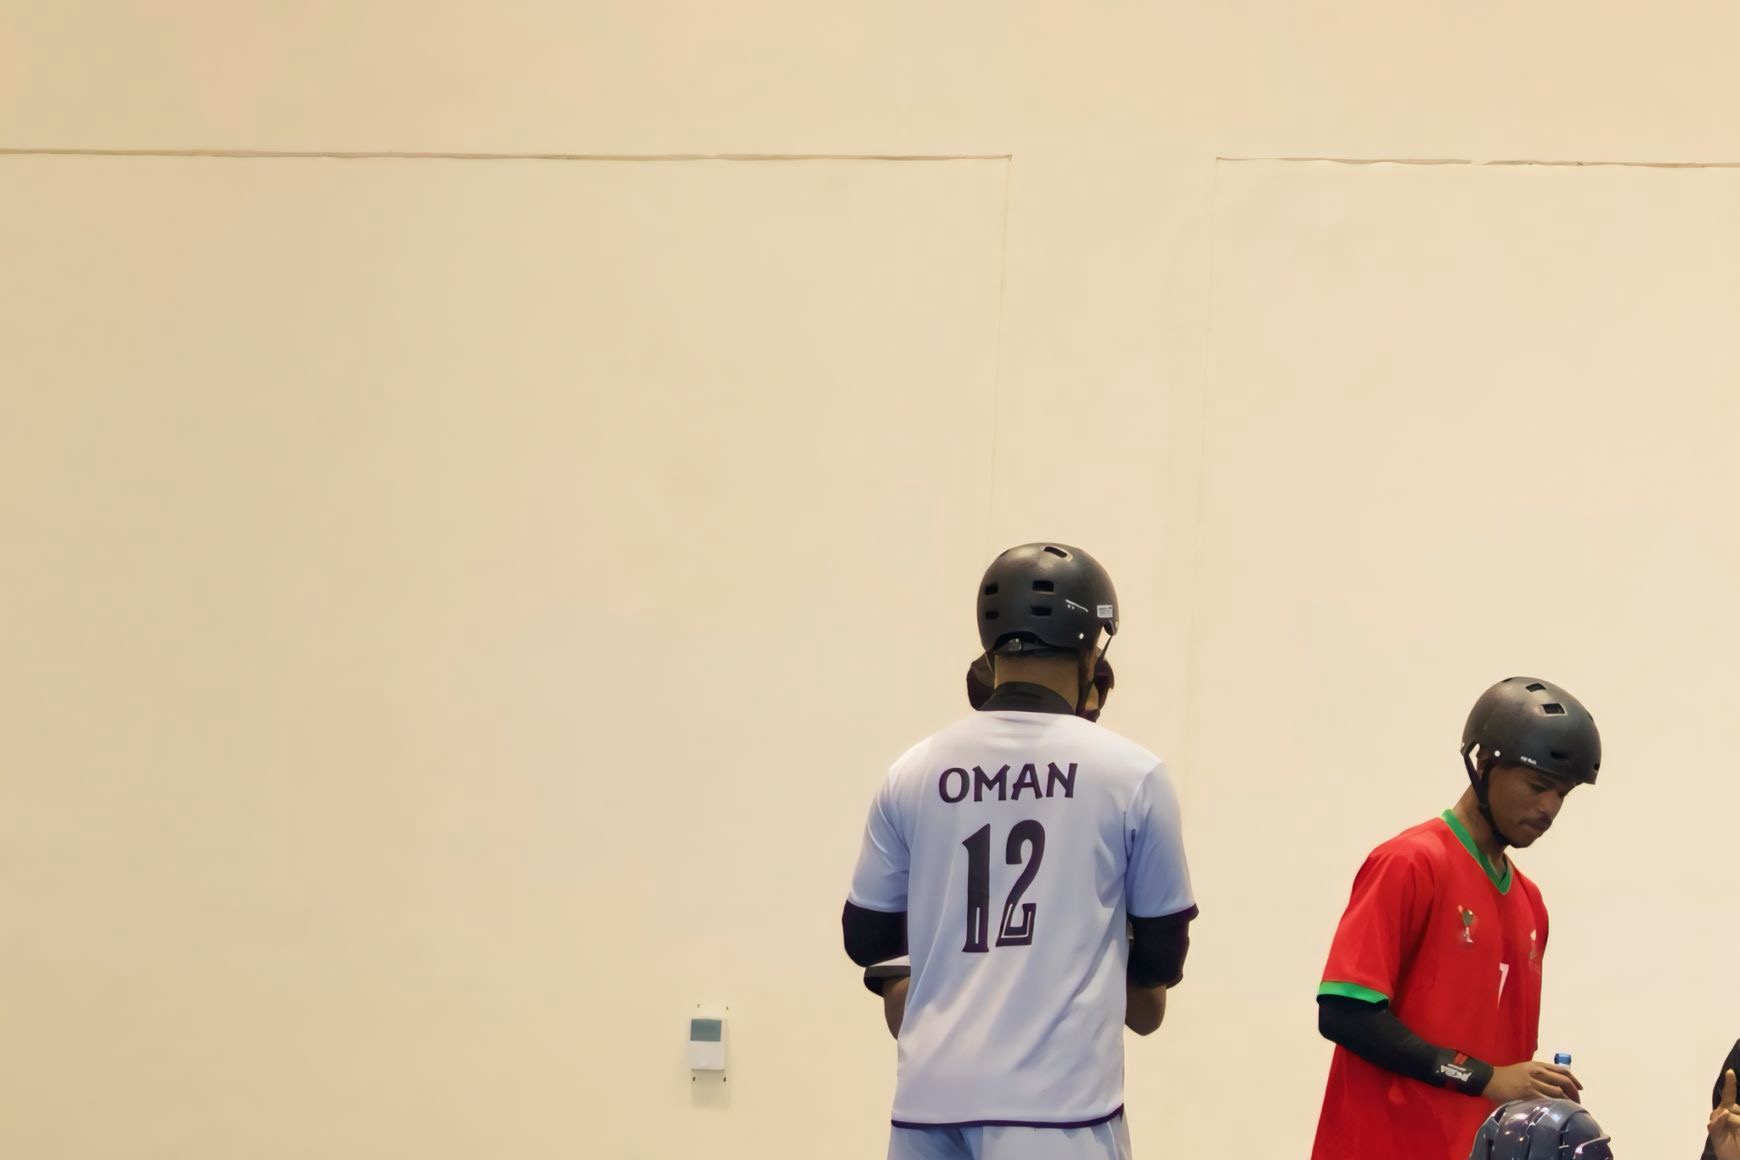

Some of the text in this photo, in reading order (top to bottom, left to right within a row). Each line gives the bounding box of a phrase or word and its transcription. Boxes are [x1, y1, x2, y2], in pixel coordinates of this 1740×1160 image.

[938, 761, 1078, 803] OMAN
[961, 819, 1046, 953] 12
[1496, 962, 1510, 1009] 7
